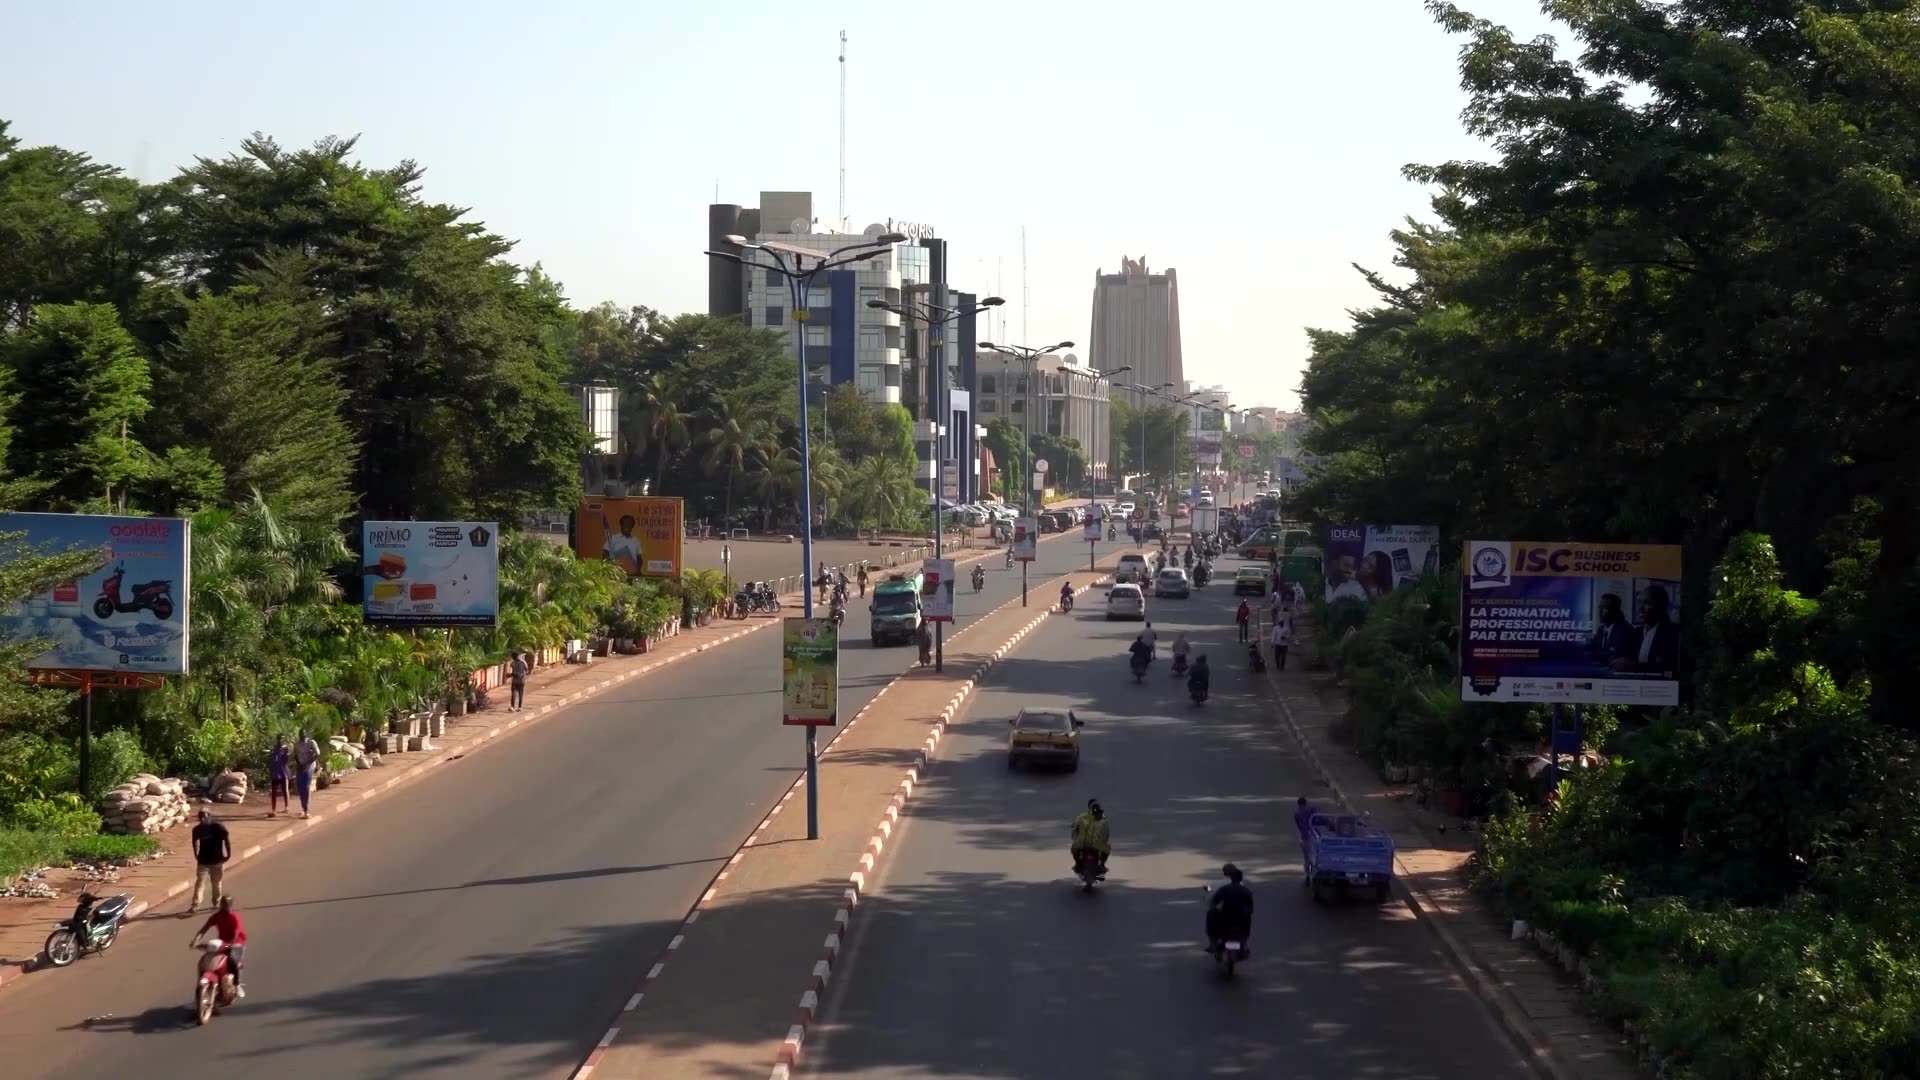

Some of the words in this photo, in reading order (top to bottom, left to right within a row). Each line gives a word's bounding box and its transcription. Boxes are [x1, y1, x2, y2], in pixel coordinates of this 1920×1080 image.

[1331, 529, 1361, 538] IDEAL
[1515, 548, 1573, 572] ISC
[1574, 550, 1641, 561] BUSINESS
[1574, 561, 1630, 573] SCHOOL
[1470, 608, 1487, 617] LA
[1491, 608, 1570, 618] FORMATION
[1469, 619, 1593, 630] PROFESSIONNELLE
[1469, 631, 1497, 641] PAR
[1500, 631, 1587, 642] EXCELLENCE.
